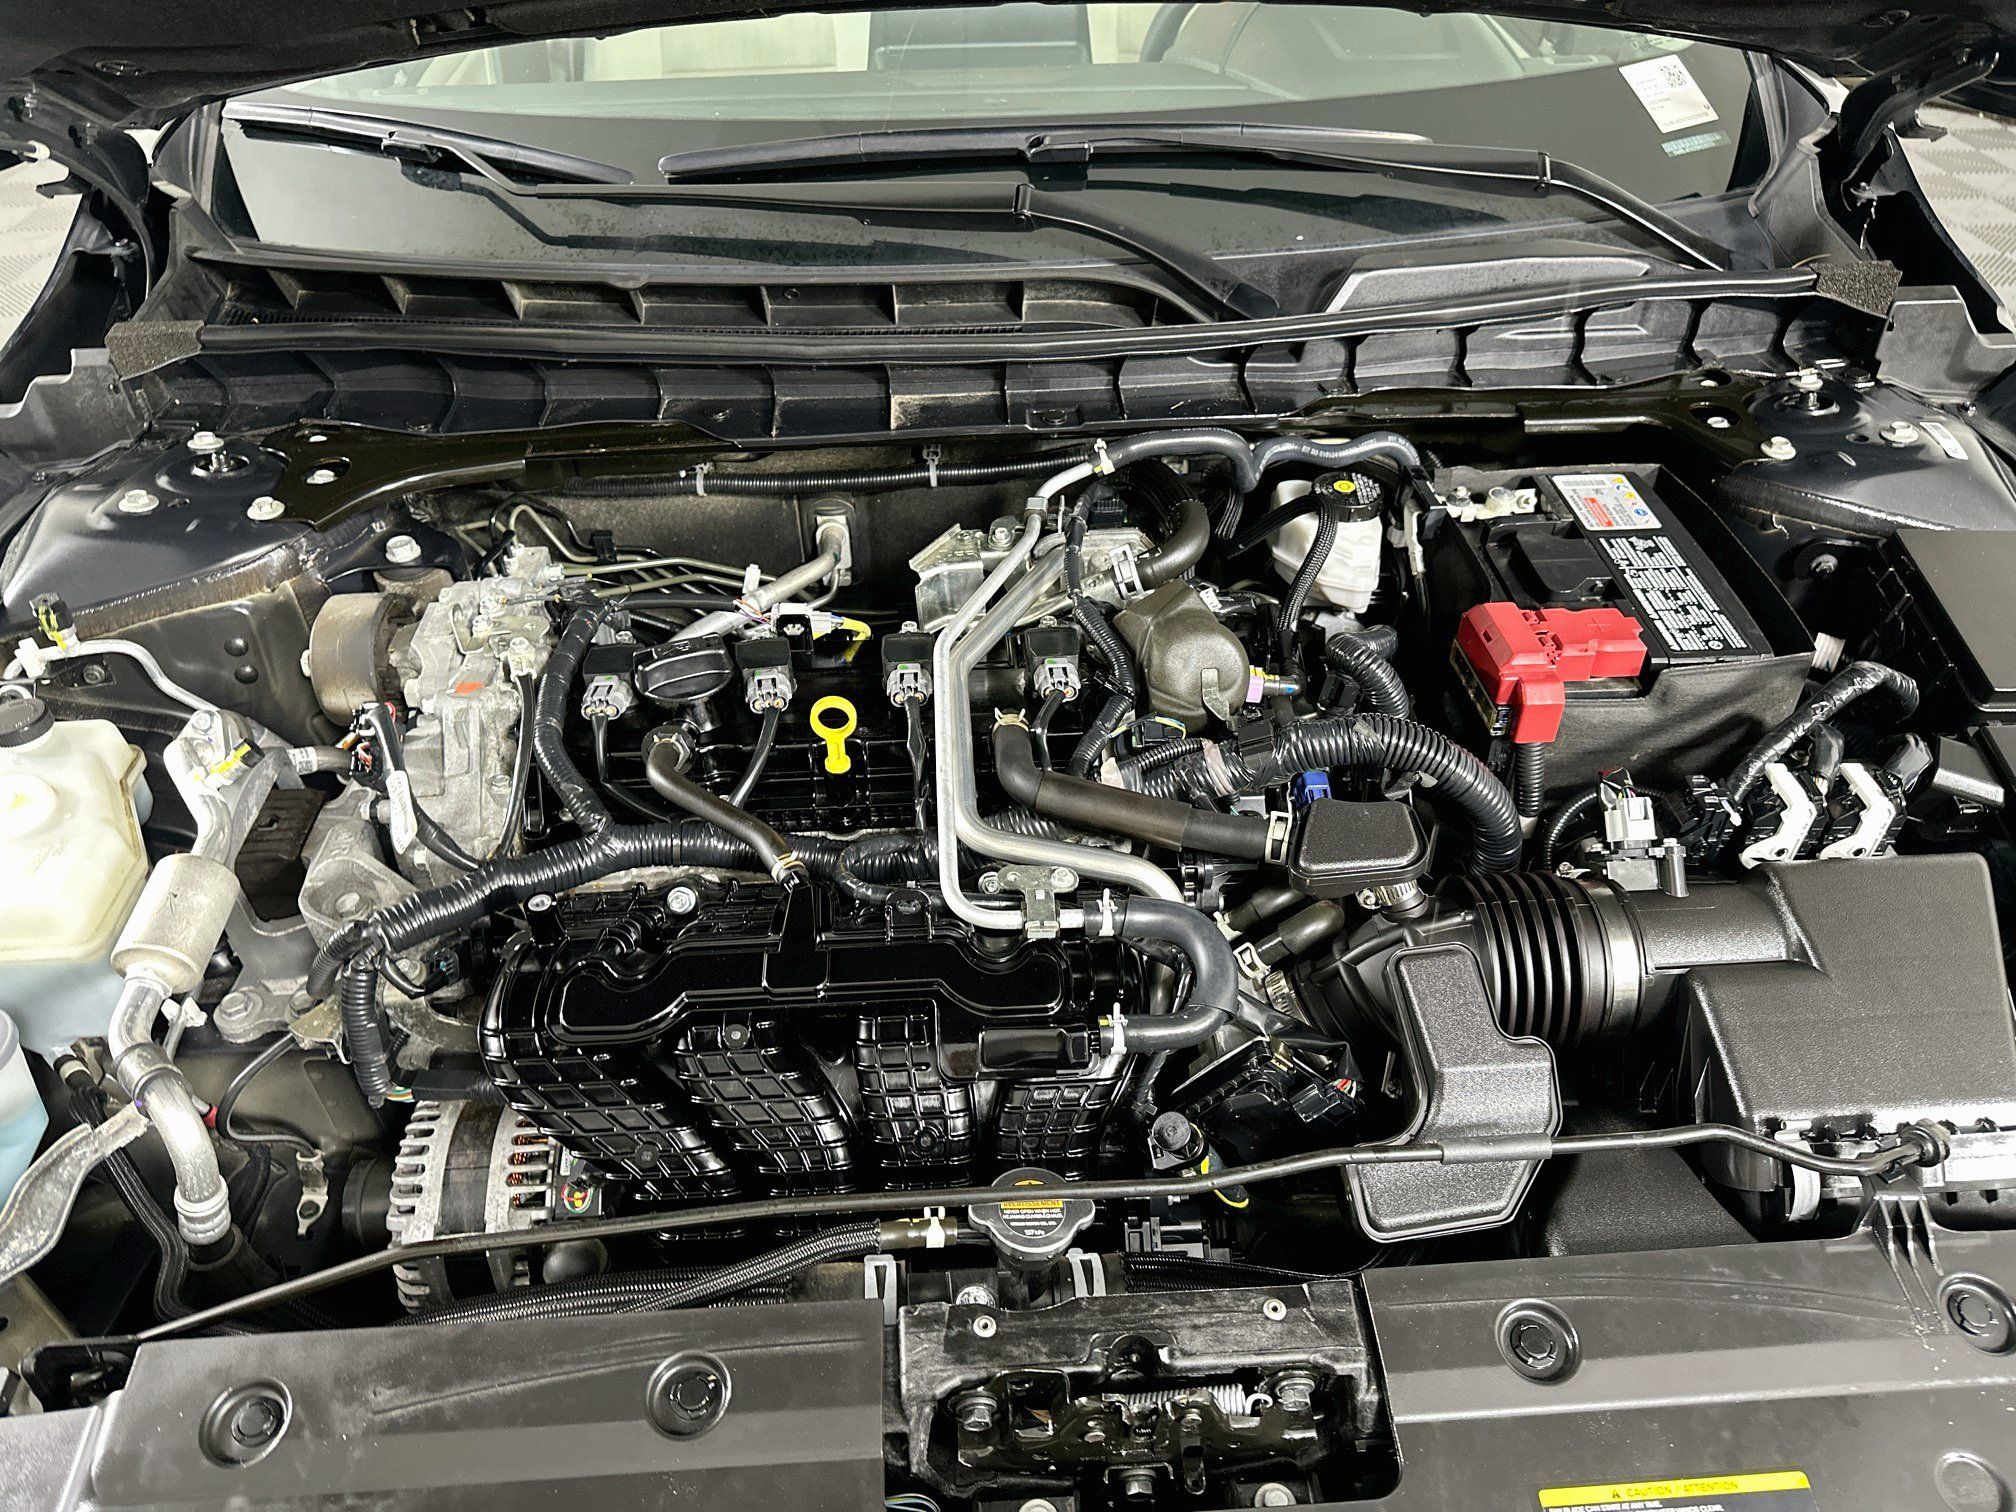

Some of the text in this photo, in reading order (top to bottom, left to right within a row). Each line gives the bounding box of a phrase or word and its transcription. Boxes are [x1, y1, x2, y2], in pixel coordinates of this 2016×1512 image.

[1626, 1486, 1672, 1497] CAUTION
[1683, 1481, 1738, 1493] ATTENTION
[1600, 1503, 1620, 1511] START
